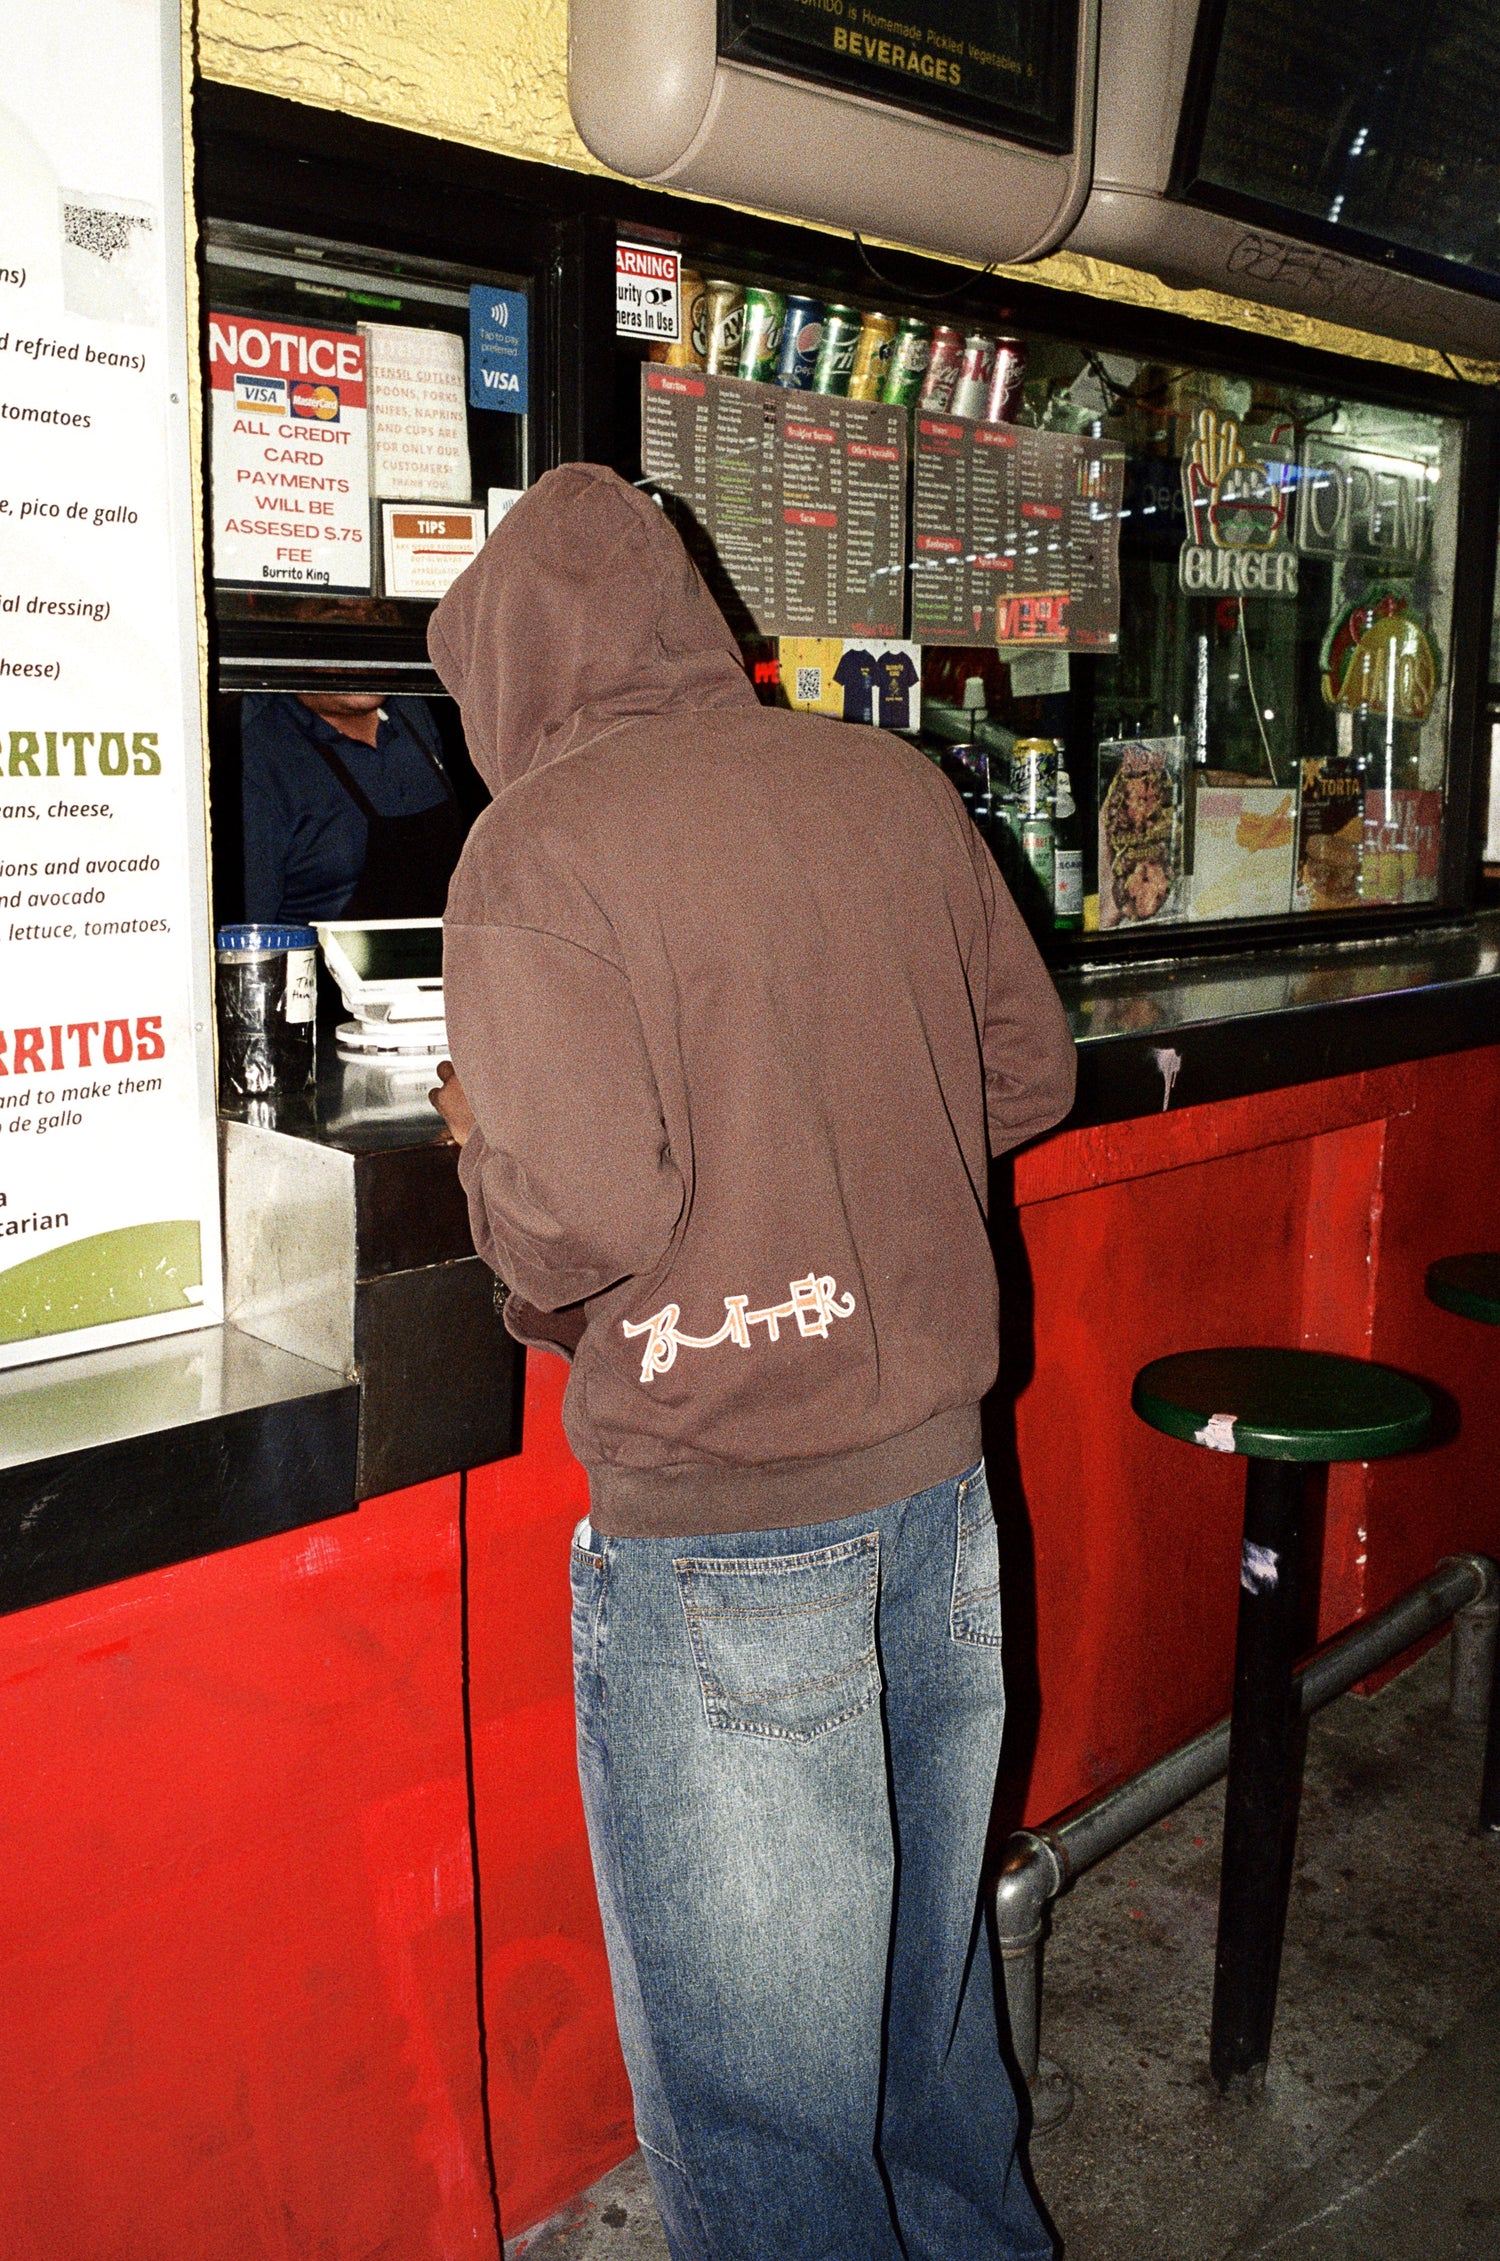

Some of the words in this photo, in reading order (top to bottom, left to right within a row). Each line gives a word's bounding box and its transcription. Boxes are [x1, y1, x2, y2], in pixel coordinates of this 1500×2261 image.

[848, 7, 857, 20] is
[862, 8, 922, 39] Homemade
[927, 29, 964, 55] Pickled
[833, 26, 961, 86] BEVERAGES
[618, 282, 642, 306] urity
[645, 309, 654, 329] In
[657, 311, 673, 332] Use
[15, 337, 79, 361] refried
[85, 345, 146, 373] beans)
[209, 321, 363, 382] NOTICE
[480, 368, 519, 393] VISA
[245, 387, 277, 403] VISA
[293, 395, 337, 410] MasterCard
[1, 403, 91, 428] tomatoes
[233, 419, 270, 436] ALL
[278, 424, 351, 445] CREDIT
[264, 447, 323, 466] CARD
[237, 469, 349, 493] PAYMENTS
[20, 498, 60, 520] pico
[66, 501, 88, 520] de
[93, 504, 138, 526] gallo
[255, 496, 304, 513] WILL
[309, 500, 335, 516] BE
[1312, 462, 1422, 559] OPEN
[225, 518, 320, 539] ASSESED
[417, 520, 446, 534] TIPS
[276, 547, 312, 563] FEE
[262, 565, 303, 580] Burrito
[306, 568, 330, 585] King
[1186, 546, 1298, 594] BURGER
[26, 596, 111, 622] dressing)
[0, 731, 162, 776] RITOS
[1321, 778, 1361, 796] TORTA
[0, 804, 40, 821] ans,
[47, 800, 114, 820] cheese,
[44, 857, 79, 875] and
[86, 855, 160, 873] avocado
[28, 888, 105, 906] avocado
[8, 922, 77, 942] lettuce,
[84, 917, 172, 936] tomatoes,
[0, 1015, 165, 1076] RITOS
[36, 1089, 55, 1105] to
[61, 1080, 111, 1101] make
[117, 1075, 163, 1095] them
[9, 1115, 31, 1133] de
[36, 1109, 82, 1135] gallo
